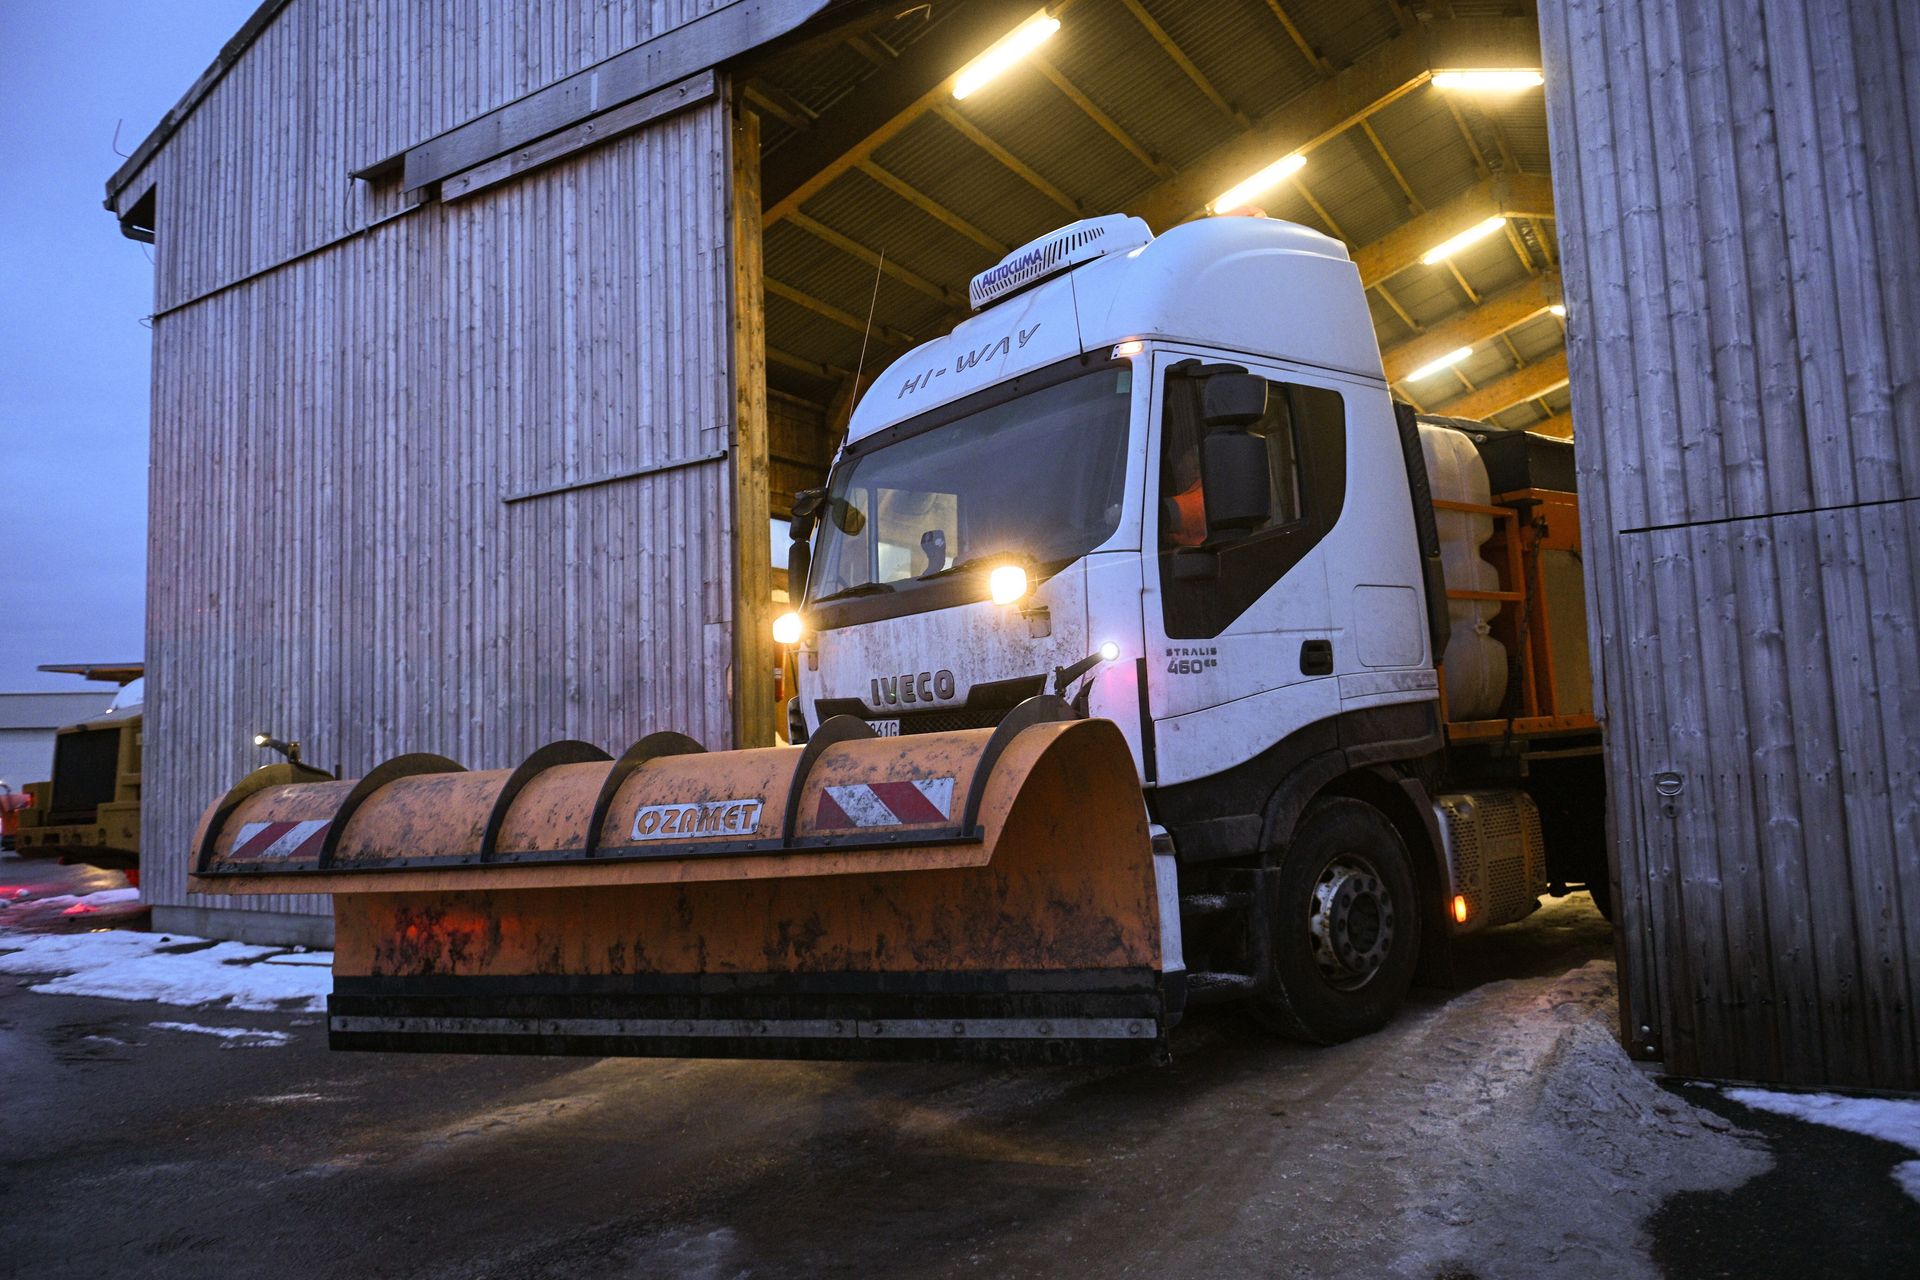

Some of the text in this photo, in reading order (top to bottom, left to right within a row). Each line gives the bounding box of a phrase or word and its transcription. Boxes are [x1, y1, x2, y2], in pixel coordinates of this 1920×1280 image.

[982, 248, 1043, 289] AUTOCLIMA
[897, 323, 1042, 400] HI-WAY
[1166, 647, 1217, 657] STRALIS
[871, 669, 955, 706] IVECO
[637, 803, 758, 835] OZAMET
